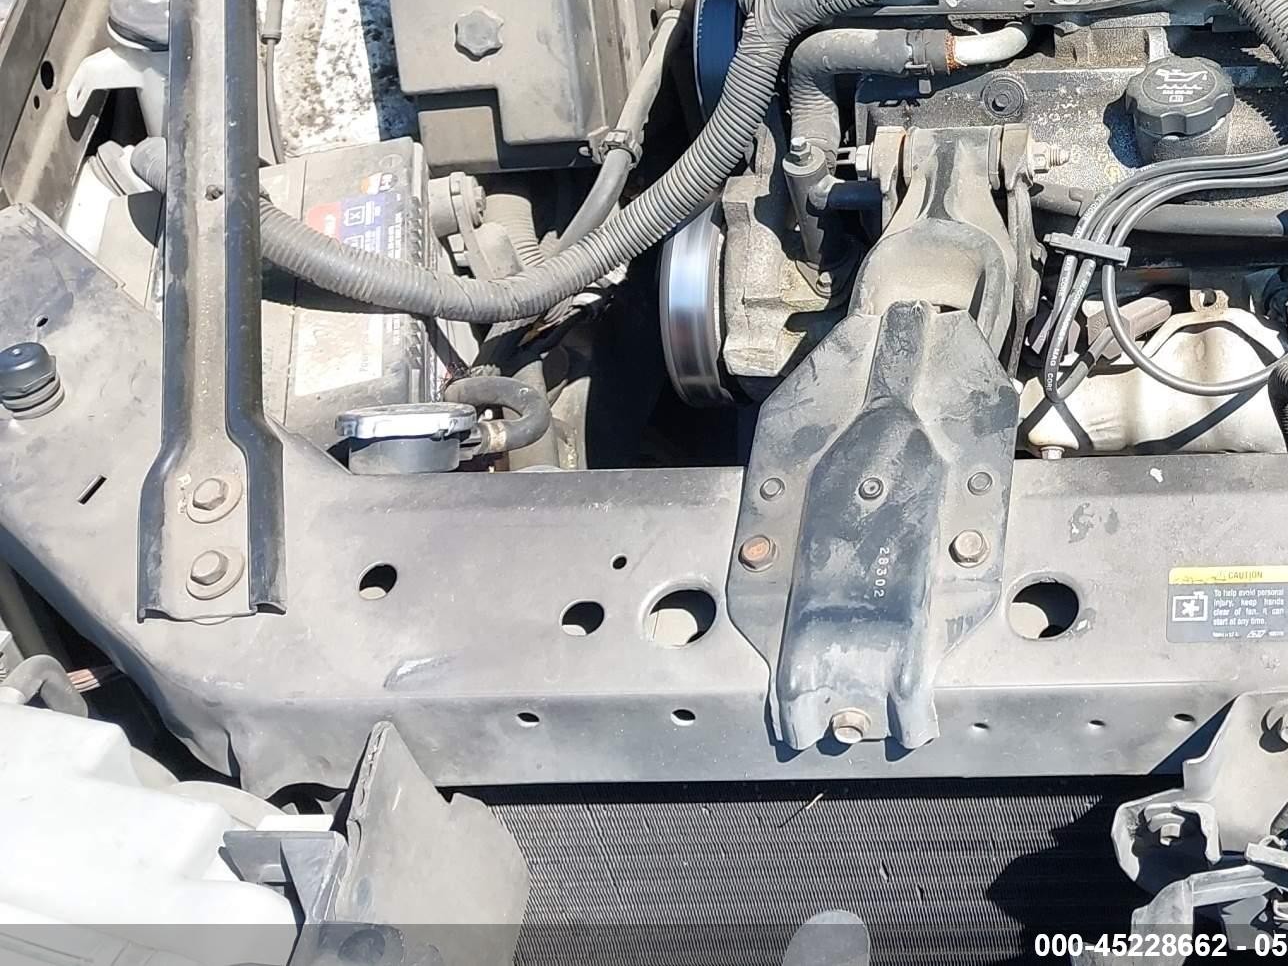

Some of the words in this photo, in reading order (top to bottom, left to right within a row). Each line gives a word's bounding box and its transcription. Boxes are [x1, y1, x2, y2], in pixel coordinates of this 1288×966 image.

[1049, 347, 1061, 367] MAG
[1228, 571, 1263, 579] CAUTION
[1214, 589, 1222, 597] To
[1257, 588, 1284, 597] personal
[1240, 598, 1257, 607] keep
[1263, 598, 1284, 606] hands
[1234, 607, 1242, 616] of
